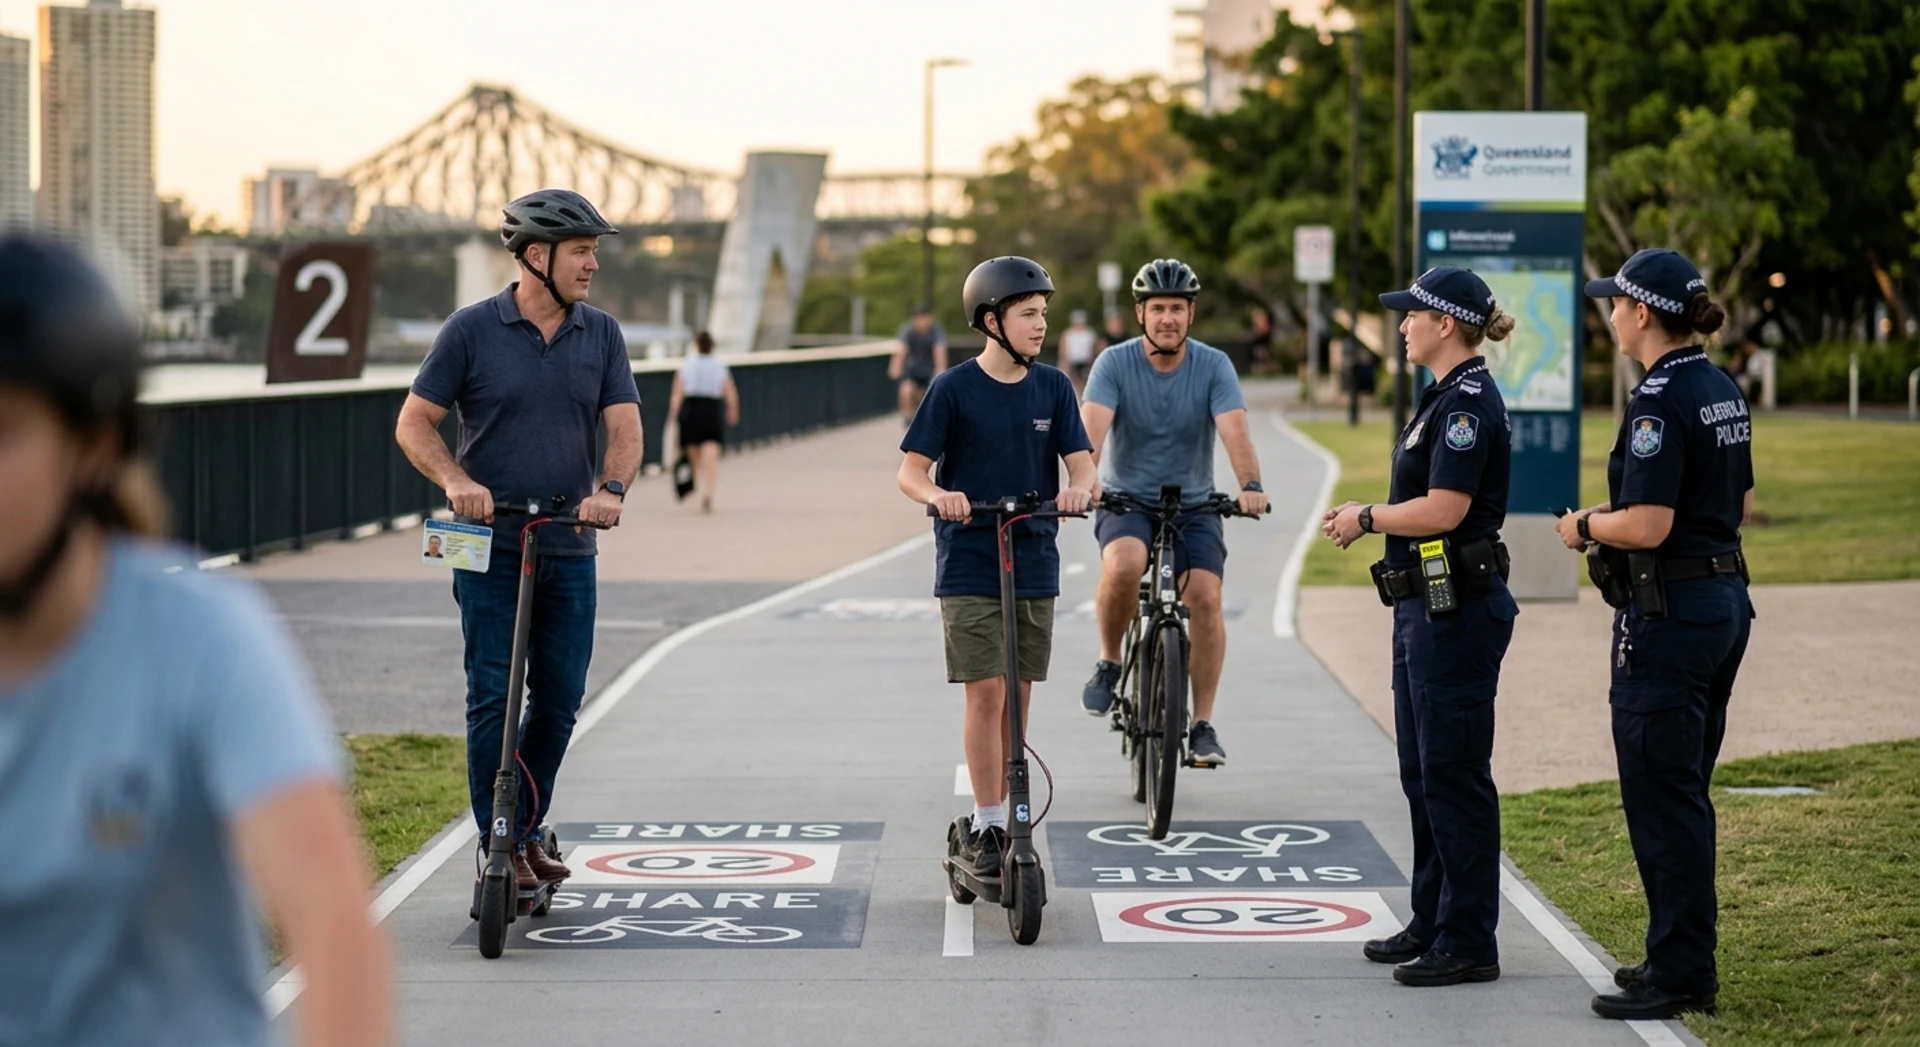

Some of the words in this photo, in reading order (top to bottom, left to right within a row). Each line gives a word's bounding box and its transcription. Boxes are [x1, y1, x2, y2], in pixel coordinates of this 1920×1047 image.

[1483, 144, 1572, 160] Queensland
[295, 259, 348, 355] 2
[1715, 421, 1750, 447] POLICE
[589, 824, 842, 838] SHARE
[626, 856, 772, 870] 20
[1091, 866, 1363, 882] SHARE
[550, 892, 820, 909] SHARE
[1165, 907, 1324, 925] 20
